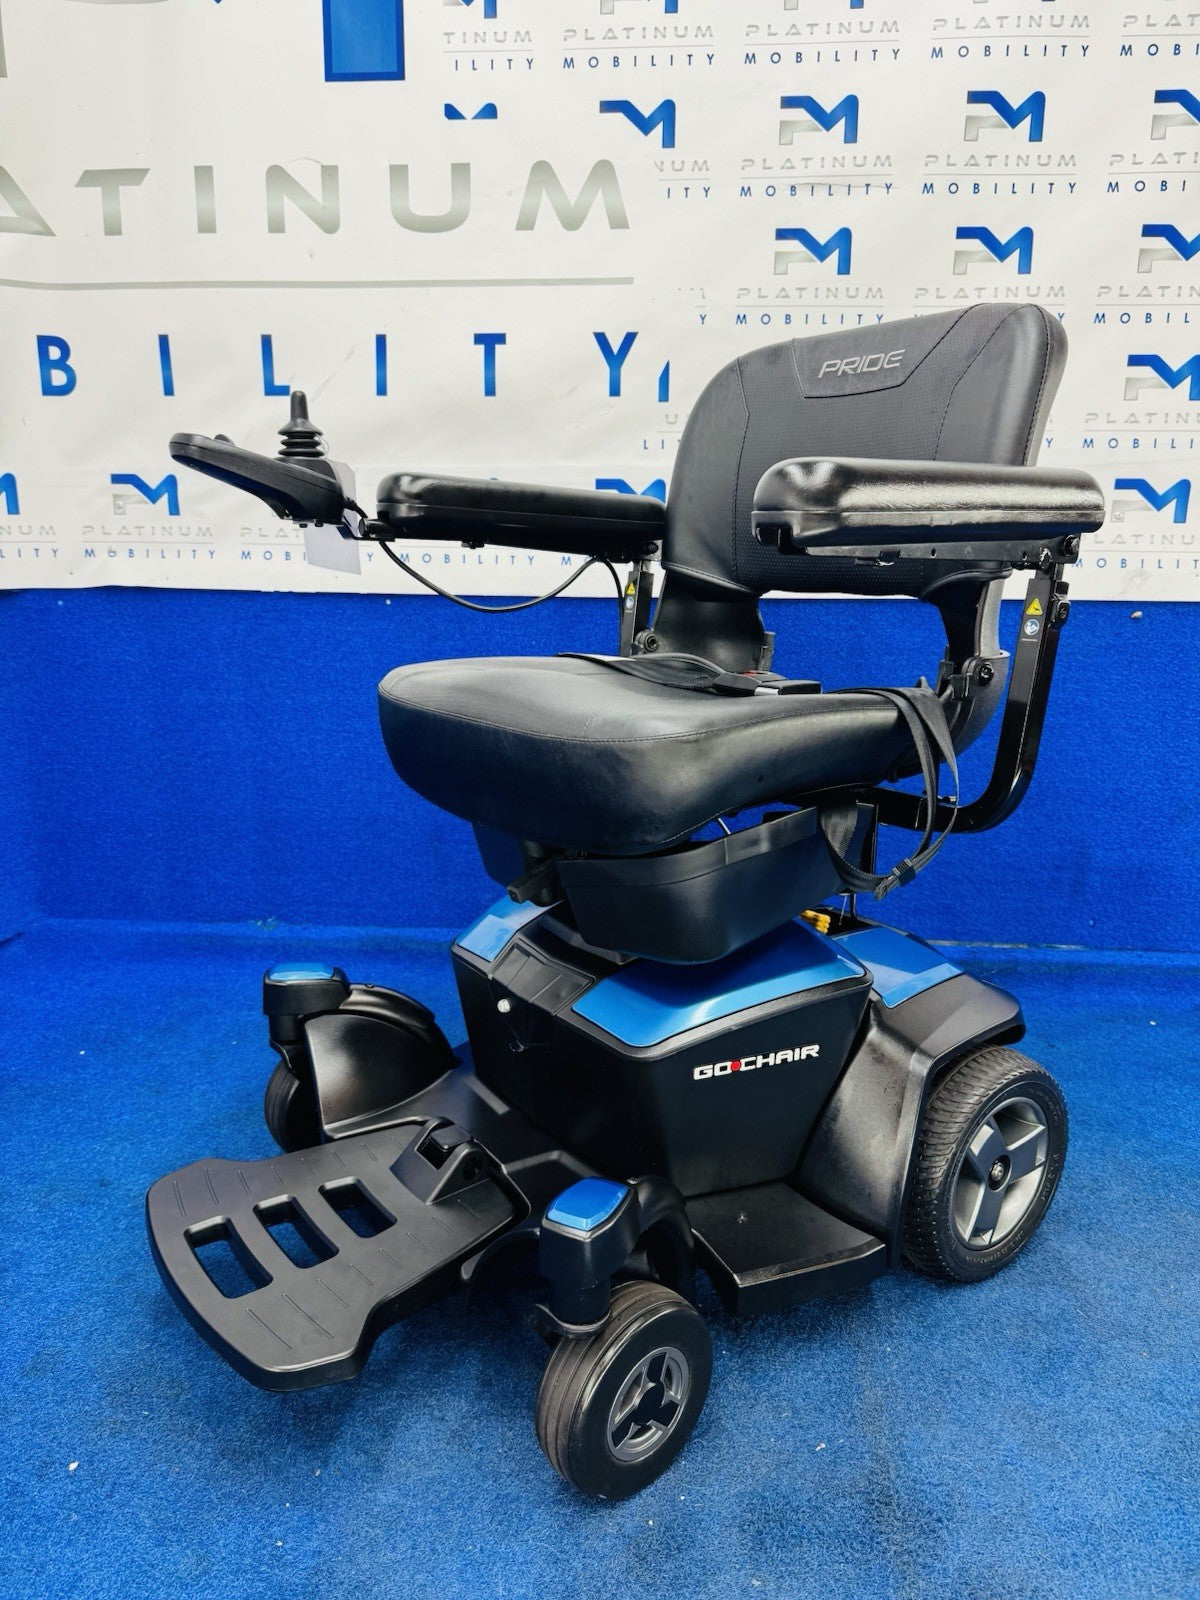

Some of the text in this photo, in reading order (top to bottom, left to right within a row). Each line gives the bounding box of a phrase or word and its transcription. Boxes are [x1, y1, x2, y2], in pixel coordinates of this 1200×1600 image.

[745, 19, 900, 37] PLATINUM
[932, 14, 1090, 31] PLATINUM
[562, 25, 714, 42] PLATINUM
[743, 48, 901, 65] MOBILITY
[930, 44, 1090, 59] MOBILITY
[562, 53, 715, 69] MOBILITY
[740, 154, 893, 171] PLATINUM
[924, 153, 1077, 168] PLATINUM
[739, 182, 893, 198] MOBILITY
[921, 182, 1077, 195] MOBILITY
[736, 286, 884, 300] PLATINUM
[914, 285, 1066, 300] PLATINUM
[735, 313, 885, 325] MOBILITY
[817, 349, 906, 379] PRIDE
[82, 525, 214, 537] PLATINUM
[84, 547, 216, 560] MOBILITY
[400, 552, 536, 566] MOBILITY
